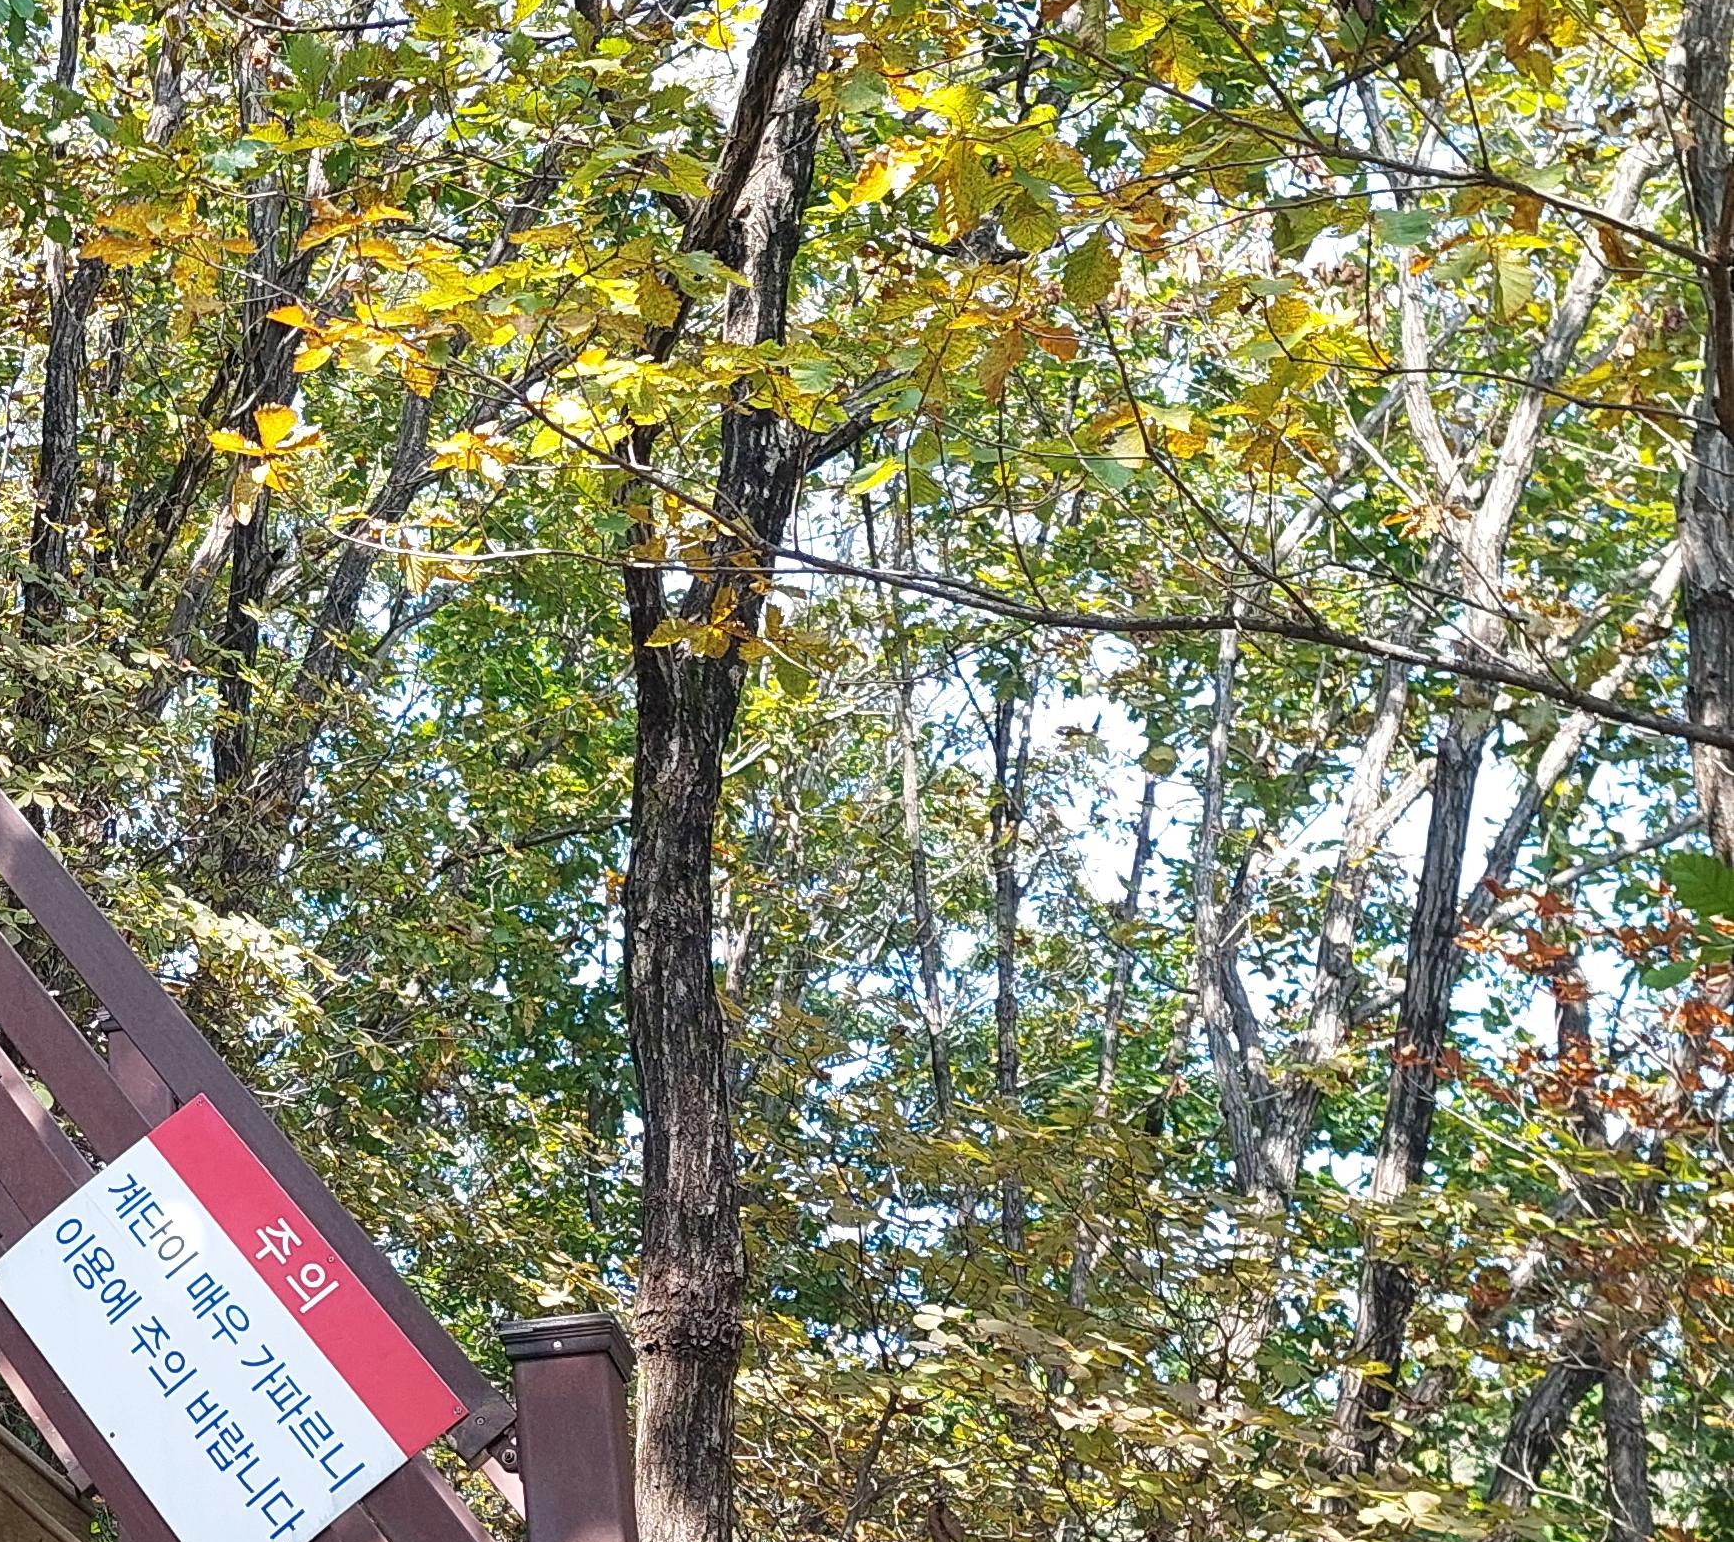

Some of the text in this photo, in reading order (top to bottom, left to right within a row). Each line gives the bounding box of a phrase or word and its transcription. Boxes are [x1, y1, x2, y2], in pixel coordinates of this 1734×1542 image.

[55, 1218, 143, 1326] 이용에
[130, 1315, 198, 1399] 주의
[107, 1172, 366, 1494] 계단이 매우 가파르니
[254, 1216, 341, 1315] 주의
